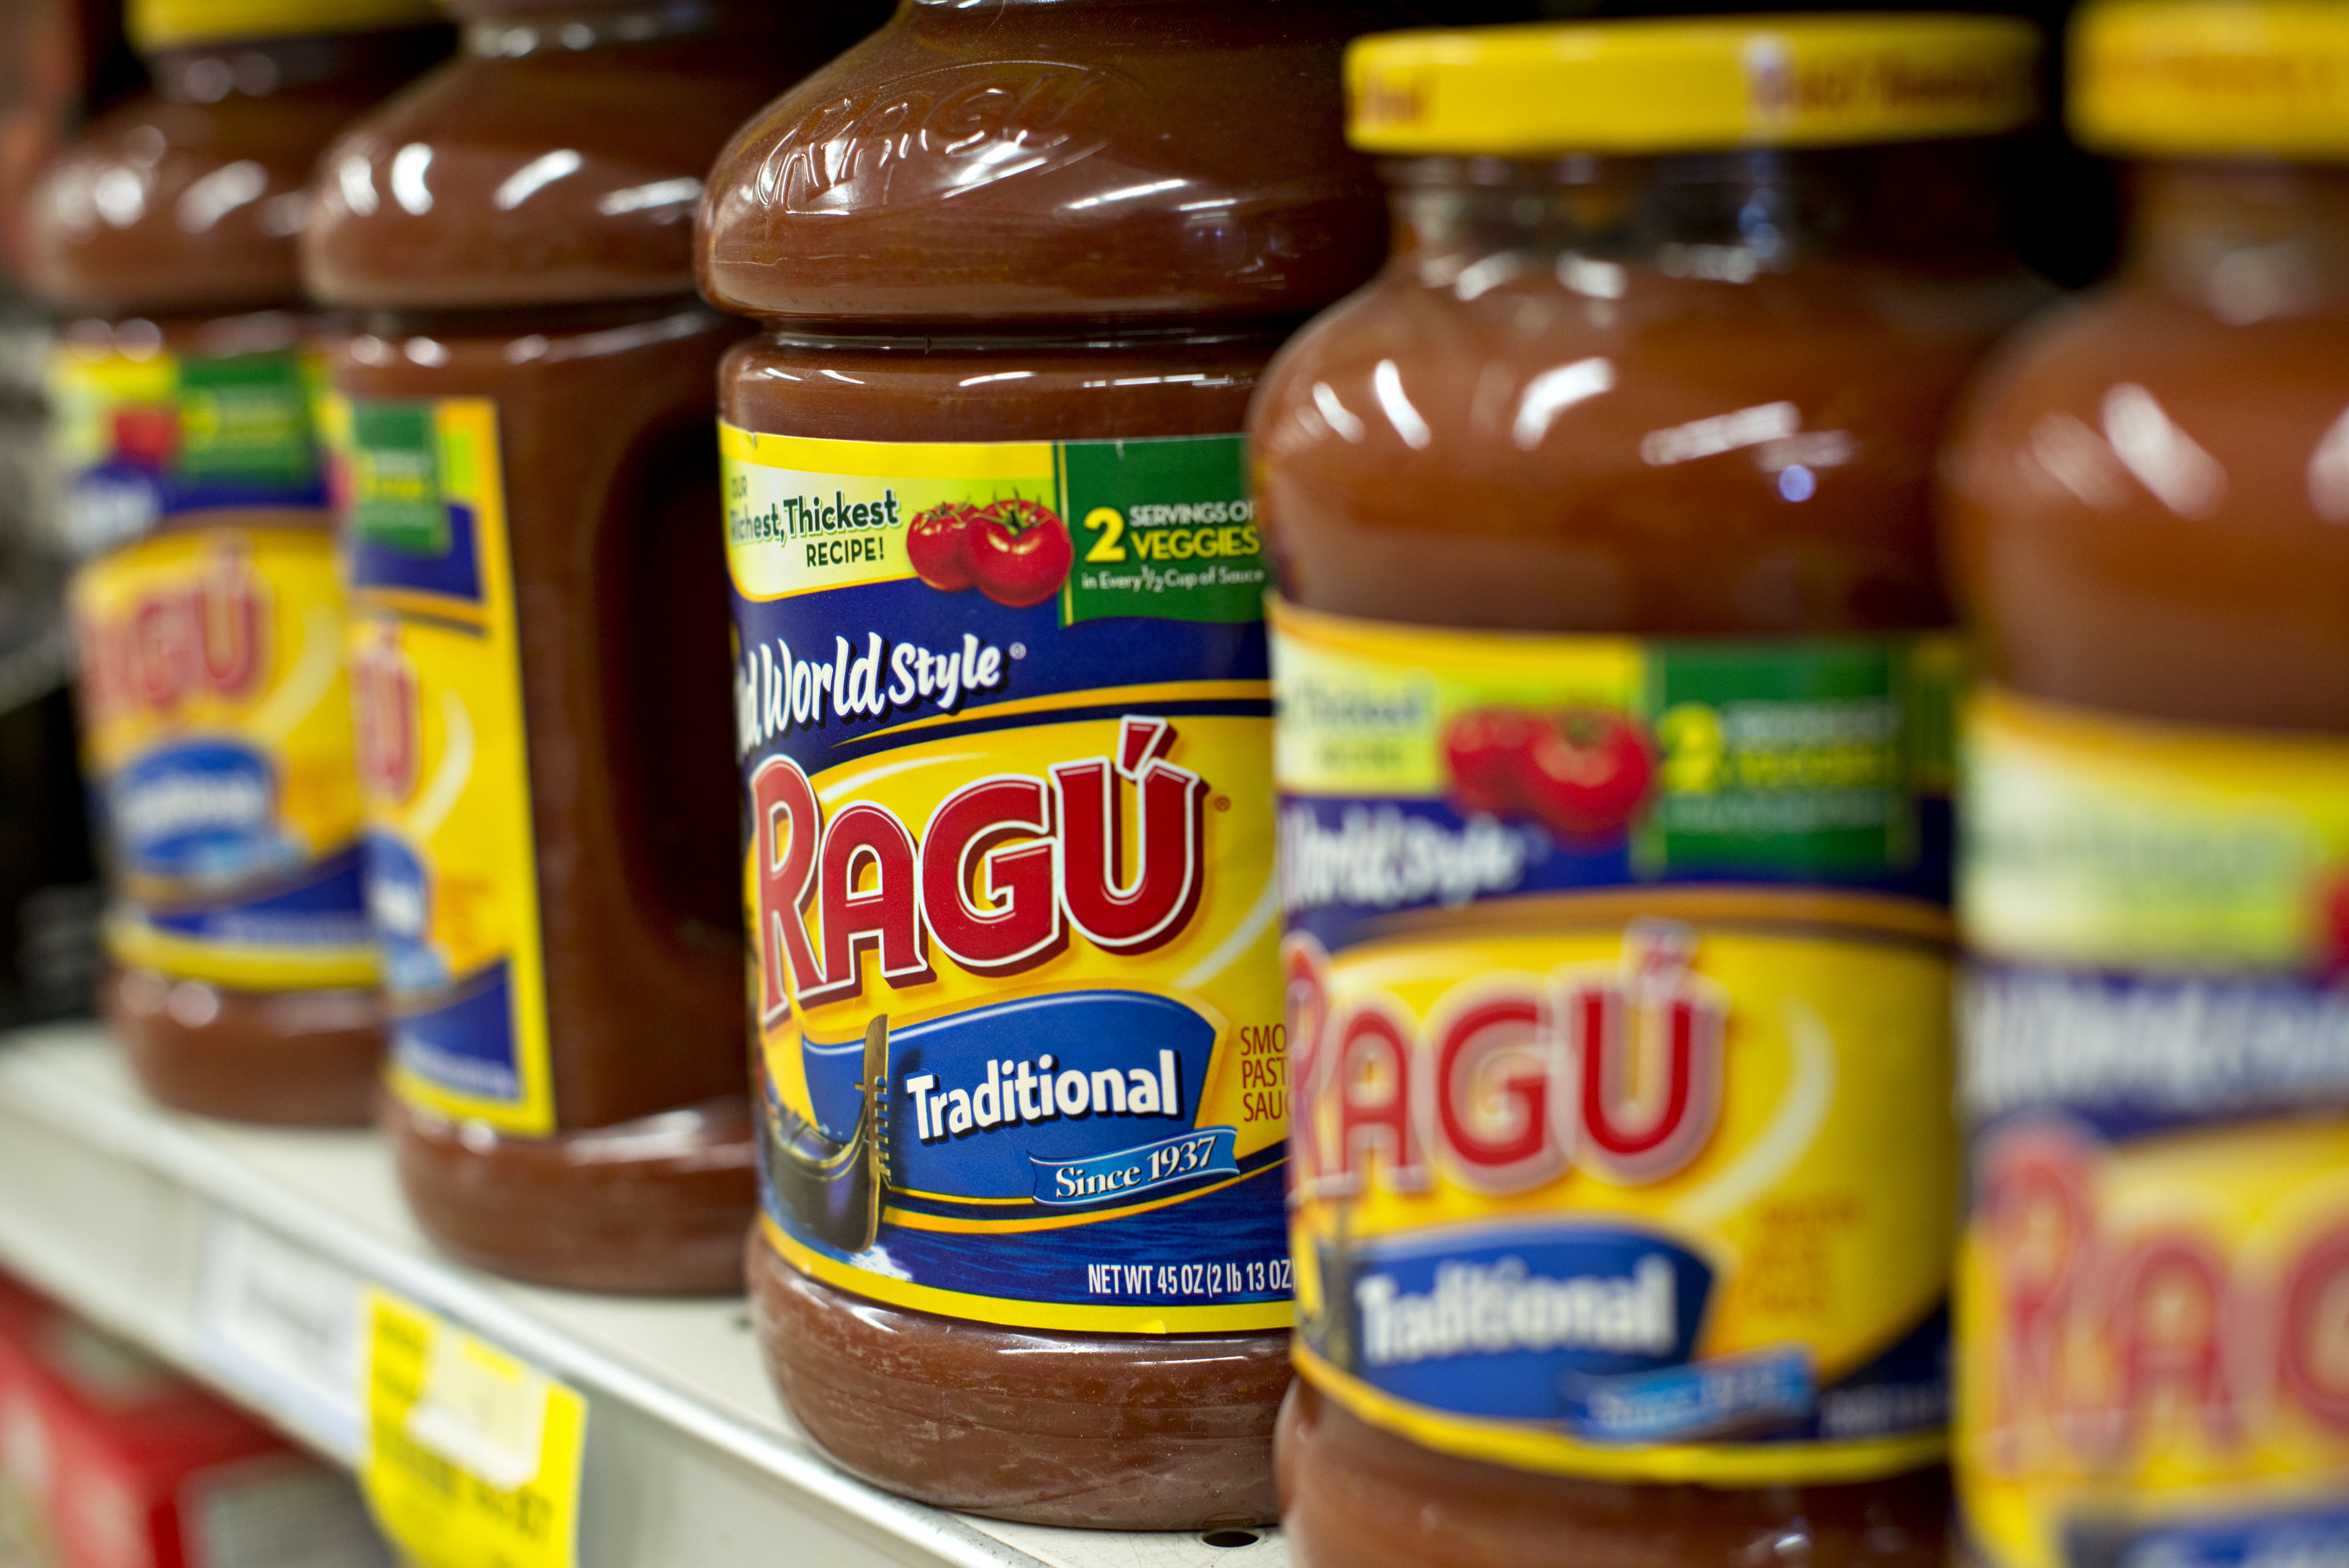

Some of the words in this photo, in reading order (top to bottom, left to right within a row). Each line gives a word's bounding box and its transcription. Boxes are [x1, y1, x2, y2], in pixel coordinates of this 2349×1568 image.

[783, 490, 900, 534] Thickest
[1084, 507, 1126, 562] 2
[1129, 502, 1229, 527] SERVINGS
[807, 536, 884, 567] RECIPE!
[1130, 526, 1260, 560] VEGGIES
[1082, 571, 1097, 589] in
[1099, 570, 1142, 593] Every
[1164, 568, 1197, 590] Cup
[1199, 566, 1216, 586] of
[1218, 566, 1265, 584] Sauce
[760, 632, 885, 739] World
[889, 633, 1001, 709] Style
[752, 715, 1209, 1023] RAGÚ
[906, 1049, 1179, 1141] Traditional
[1056, 1166, 1142, 1197] Since
[1147, 1136, 1217, 1182] 1937
[1088, 1264, 1120, 1294] NET
[1124, 1265, 1153, 1294] WT
[1157, 1266, 1177, 1294] 45
[1182, 1264, 1204, 1294] OZ
[1207, 1263, 1222, 1298] (2
[1227, 1263, 1241, 1293] lb
[1246, 1262, 1264, 1291] 13
